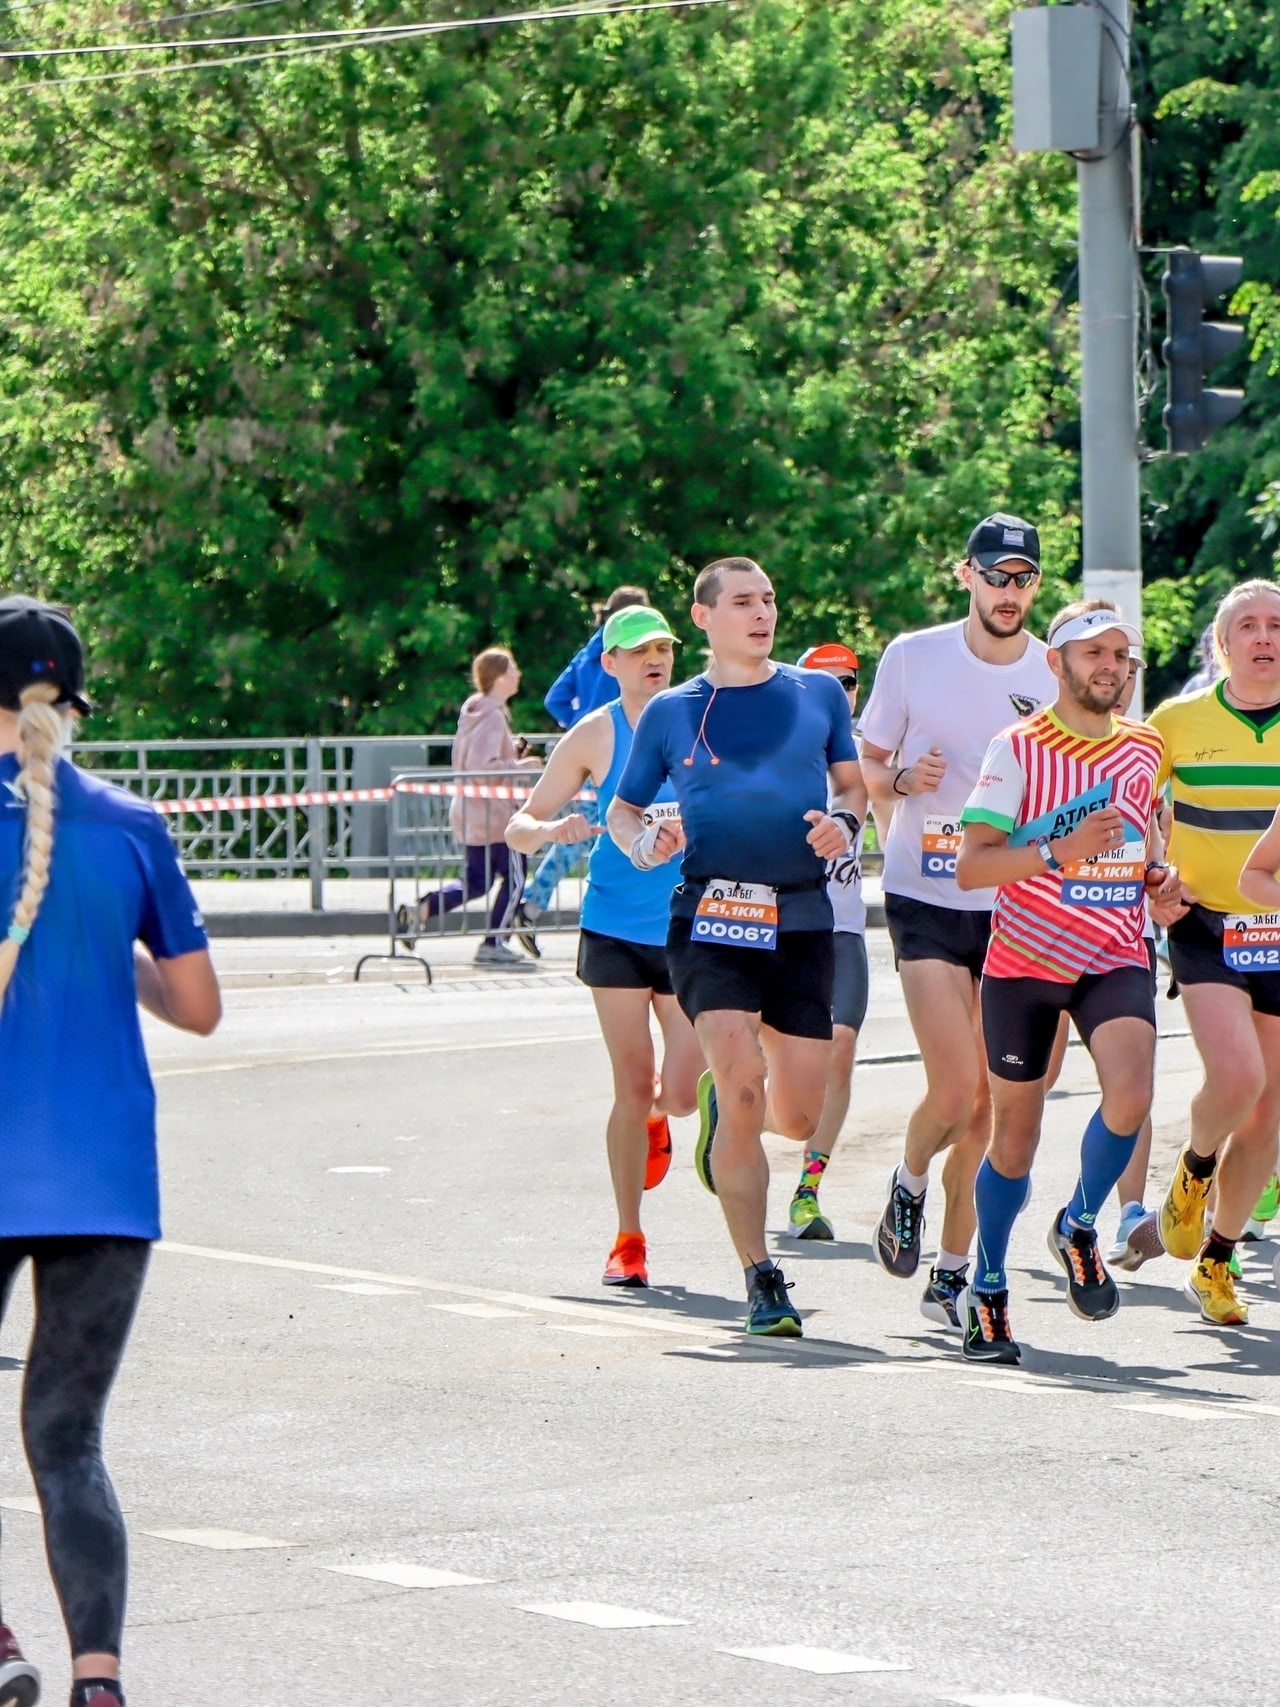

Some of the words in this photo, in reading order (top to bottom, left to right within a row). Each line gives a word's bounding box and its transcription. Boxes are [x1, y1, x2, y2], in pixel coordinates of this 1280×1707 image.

[1077, 865, 1134, 879] 21,1КМ
[727, 888, 738, 898] ЗА
[740, 889, 753, 899] БЕГ
[1070, 885, 1137, 902] 00125
[706, 902, 765, 919] 21,1КМ
[1253, 914, 1263, 925] ЗА
[1264, 914, 1278, 925] БЕГ
[696, 920, 774, 943] 00067
